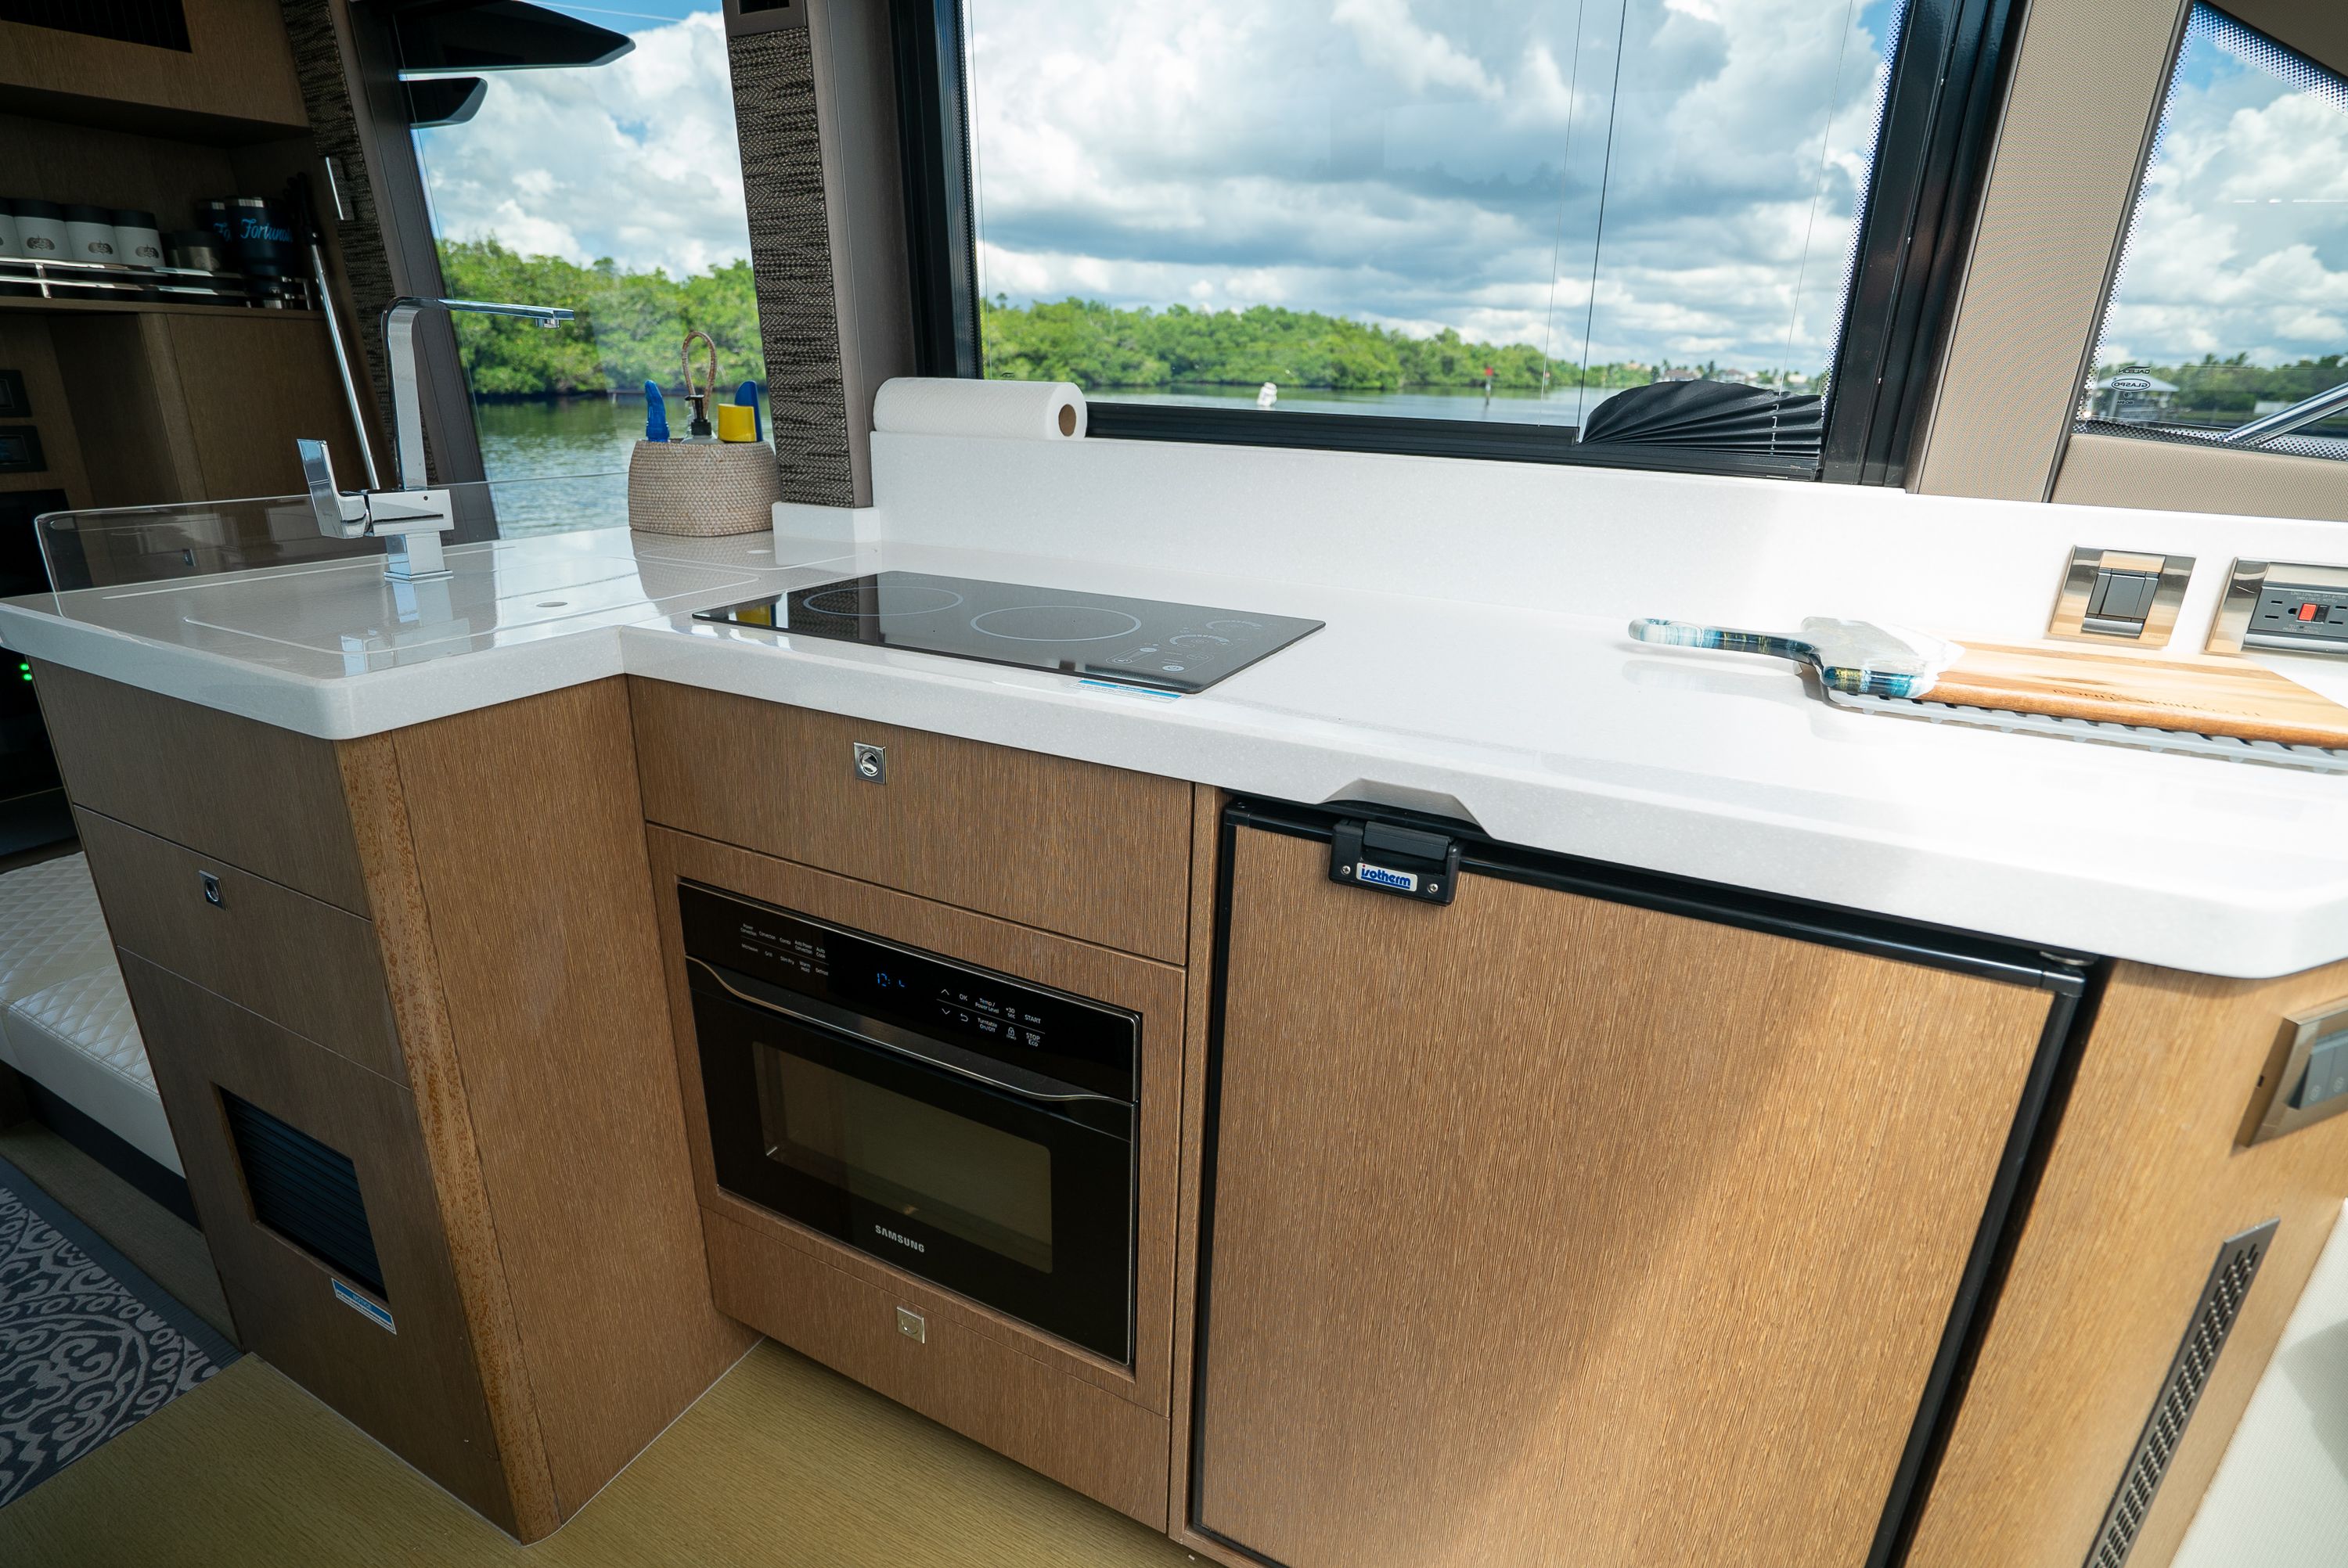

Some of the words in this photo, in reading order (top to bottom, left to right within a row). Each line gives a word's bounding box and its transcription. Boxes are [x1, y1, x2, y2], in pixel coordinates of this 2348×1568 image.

[1361, 864, 1411, 886] isotherm
[1025, 1014, 1041, 1024] START
[1026, 1032, 1040, 1041] STOP
[1028, 1038, 1039, 1047] Eco
[874, 1225, 925, 1253] SAMSUNG
